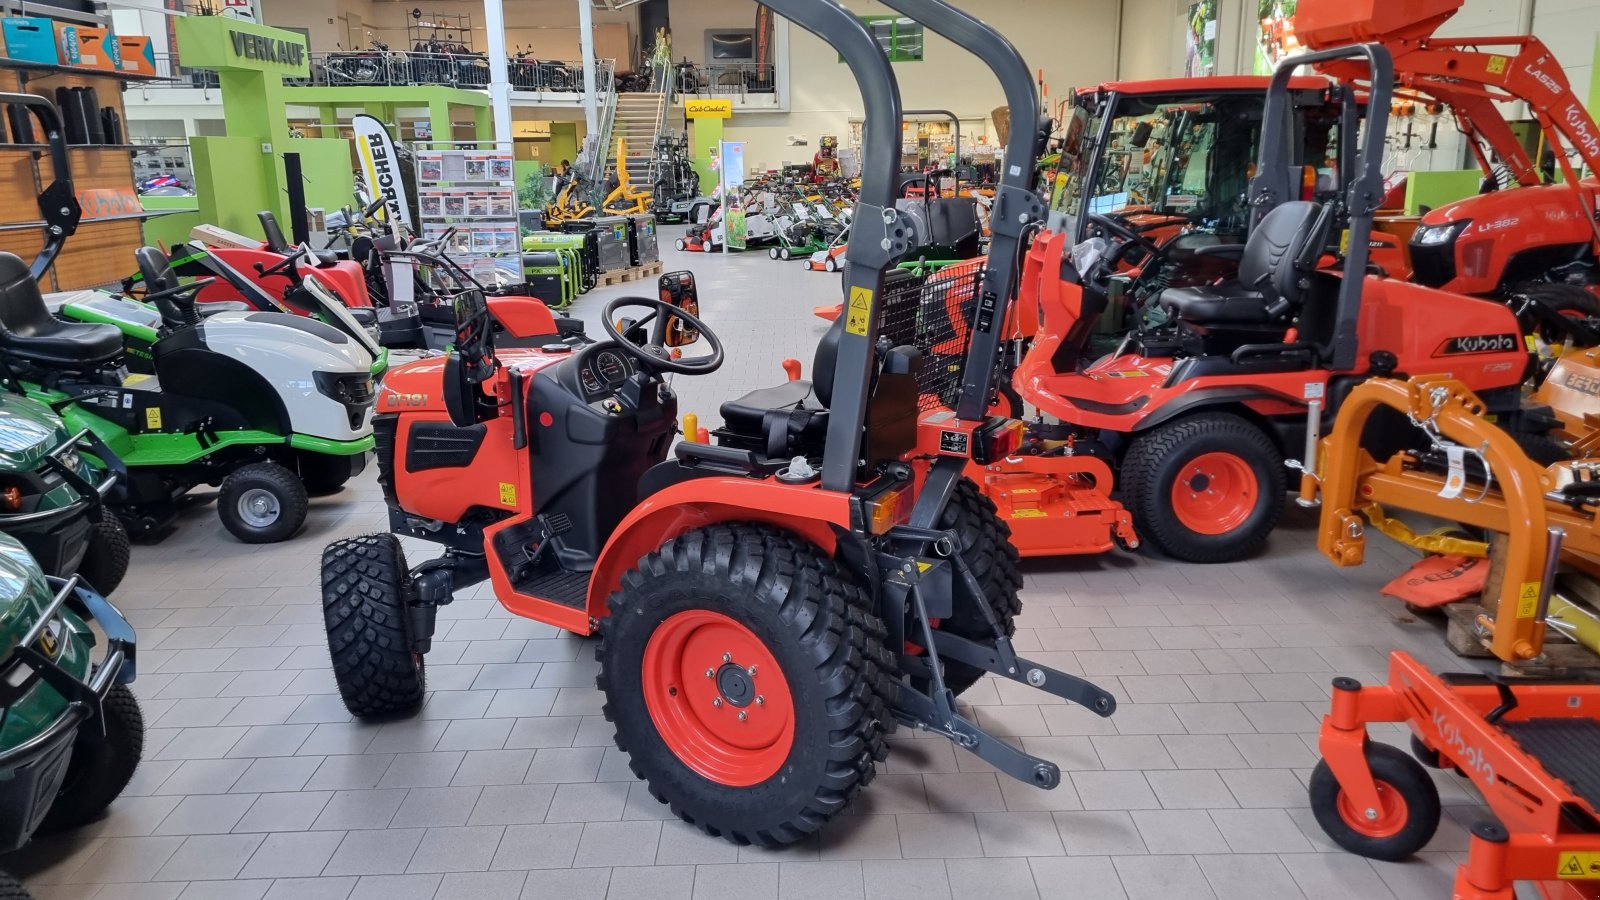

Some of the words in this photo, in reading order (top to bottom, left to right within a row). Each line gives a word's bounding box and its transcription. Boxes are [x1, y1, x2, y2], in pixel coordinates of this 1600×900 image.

[67, 30, 77, 60] Kubota
[111, 39, 120, 66] Kubota
[229, 29, 305, 66] VERKAUF
[1524, 63, 1563, 94] LA525
[688, 105, 703, 113] Cub
[703, 104, 727, 112] Cadet
[1565, 103, 1600, 157] Kubota
[1457, 335, 1514, 352] Kubota
[1432, 706, 1495, 785] Kubota
